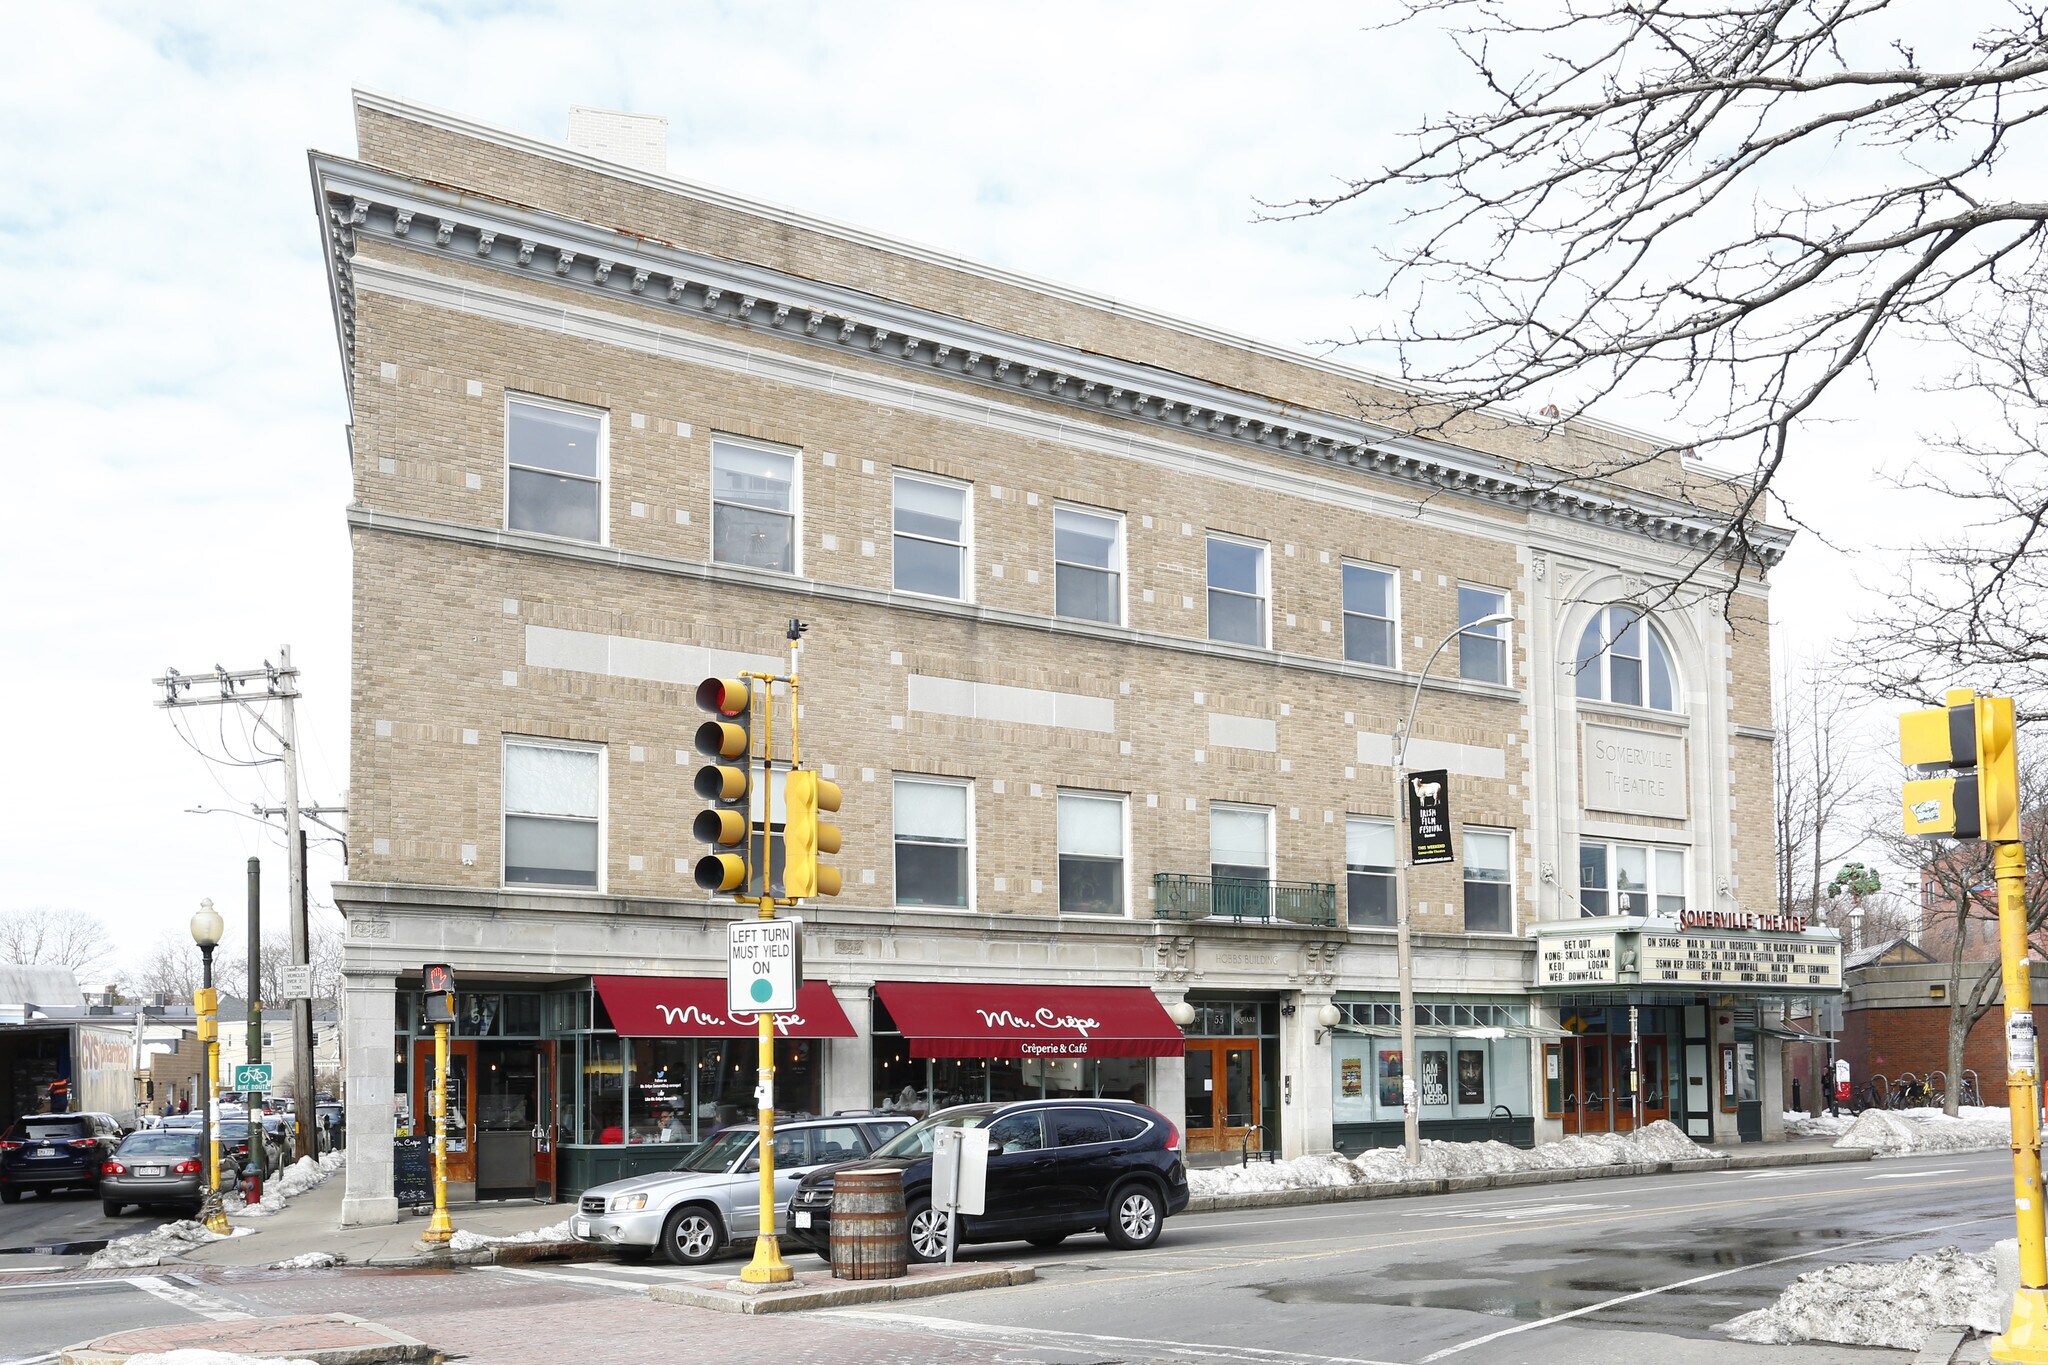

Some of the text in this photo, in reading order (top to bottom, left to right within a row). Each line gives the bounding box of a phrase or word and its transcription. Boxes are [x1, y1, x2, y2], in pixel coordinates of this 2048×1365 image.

[1595, 740, 1672, 770] SOMERVILLE
[1605, 771, 1665, 797] THEATRE
[1420, 809, 1436, 817] IRISH
[1421, 817, 1436, 826] FILM
[1419, 824, 1443, 834] FESTIVAL
[1680, 909, 1806, 933] SOMERVILLE THEATRE
[733, 928, 789, 943] LEFT TURN
[1564, 939, 1592, 950] GET OUT
[1647, 937, 1656, 947] ON
[1658, 938, 1682, 948] STAGE:
[1686, 939, 1698, 949] MAR
[1710, 940, 1726, 950] ALLOY
[1762, 942, 1773, 952] THE
[1773, 943, 1789, 953] BLACK
[1790, 944, 1807, 954] PIRATE
[1816, 945, 1836, 955] VARIETE
[733, 944, 790, 959] MUST YIELD
[1544, 949, 1611, 962] KONG: SKULL ISLAND
[1688, 950, 1795, 963] MAR 23-26 IRISH FILM FESTIVAL BOSTON
[1215, 953, 1279, 966] HOBBS BUILDING
[1549, 960, 1609, 972] KEDI LOGAN
[753, 960, 770, 975] ON
[1655, 959, 1672, 969] 35MM
[1673, 960, 1684, 970] REP
[1685, 961, 1706, 971] SERIES:
[1711, 961, 1723, 971] MAR
[1724, 962, 1732, 971] 22
[1734, 962, 1759, 973] DOWNFALL
[1771, 964, 1781, 973] MAR
[1807, 965, 1830, 975] TERMINUS
[1550, 971, 1604, 982] WED: DOWNFALL
[1661, 970, 1820, 984] LOGAN GET OUT KONG: SKULL ISLAND KEDI
[656, 1004, 726, 1026] Mr.
[1214, 1015, 1224, 1025] 55
[1235, 1016, 1257, 1025] SQUARE
[976, 1007, 1100, 1038] Mr. Crêpe
[82, 1034, 129, 1071] CVS pharmacy
[1021, 1043, 1088, 1056] Crêperie & Café
[1426, 1064, 1437, 1075] AM
[1423, 1074, 1438, 1084] NOT
[1423, 1084, 1443, 1095] YOUR
[1423, 1094, 1447, 1105] NEGRO
